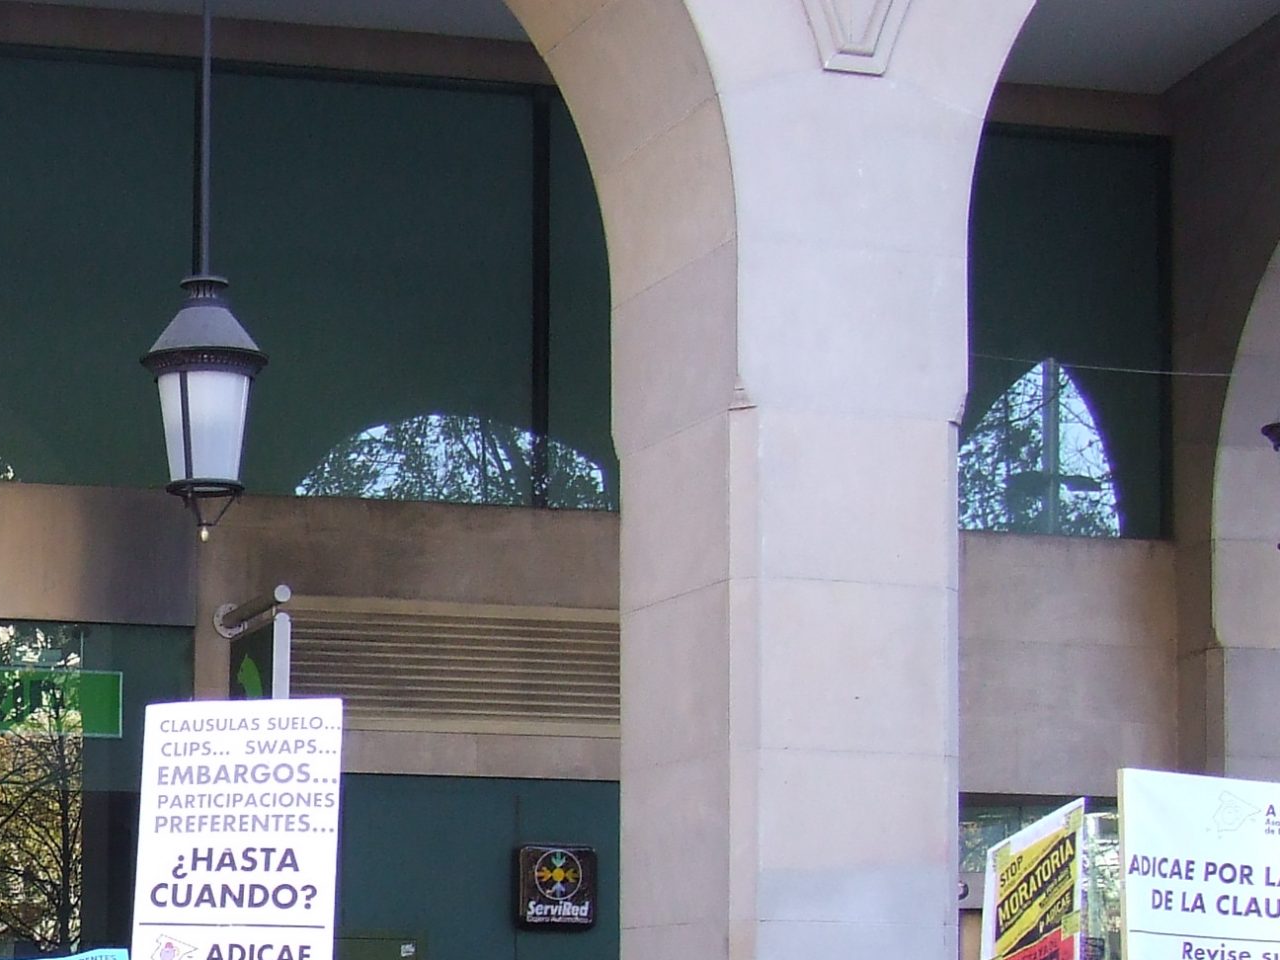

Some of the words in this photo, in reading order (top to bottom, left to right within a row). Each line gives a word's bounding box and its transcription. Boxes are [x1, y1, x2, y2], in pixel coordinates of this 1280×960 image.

[160, 717, 260, 733] CLAUSULAS
[267, 716, 341, 731] SUELO...
[161, 741, 230, 757] CLIPS...
[245, 739, 337, 755] SWAPS...
[158, 763, 338, 786] EMBARGOS...
[158, 792, 335, 809] PARTICIPACIONES
[155, 814, 335, 833] PREFERENTES...
[172, 847, 300, 879] ¿HASTA
[1000, 856, 1023, 887] STOP
[1128, 854, 1195, 880] ADICAE
[1204, 861, 1254, 885] POR
[998, 839, 1074, 927] MORATORIA
[150, 883, 318, 910] CUANDO?
[527, 901, 590, 916] ServiRed
[1151, 889, 1173, 911] DE
[1181, 891, 1206, 914] LA
